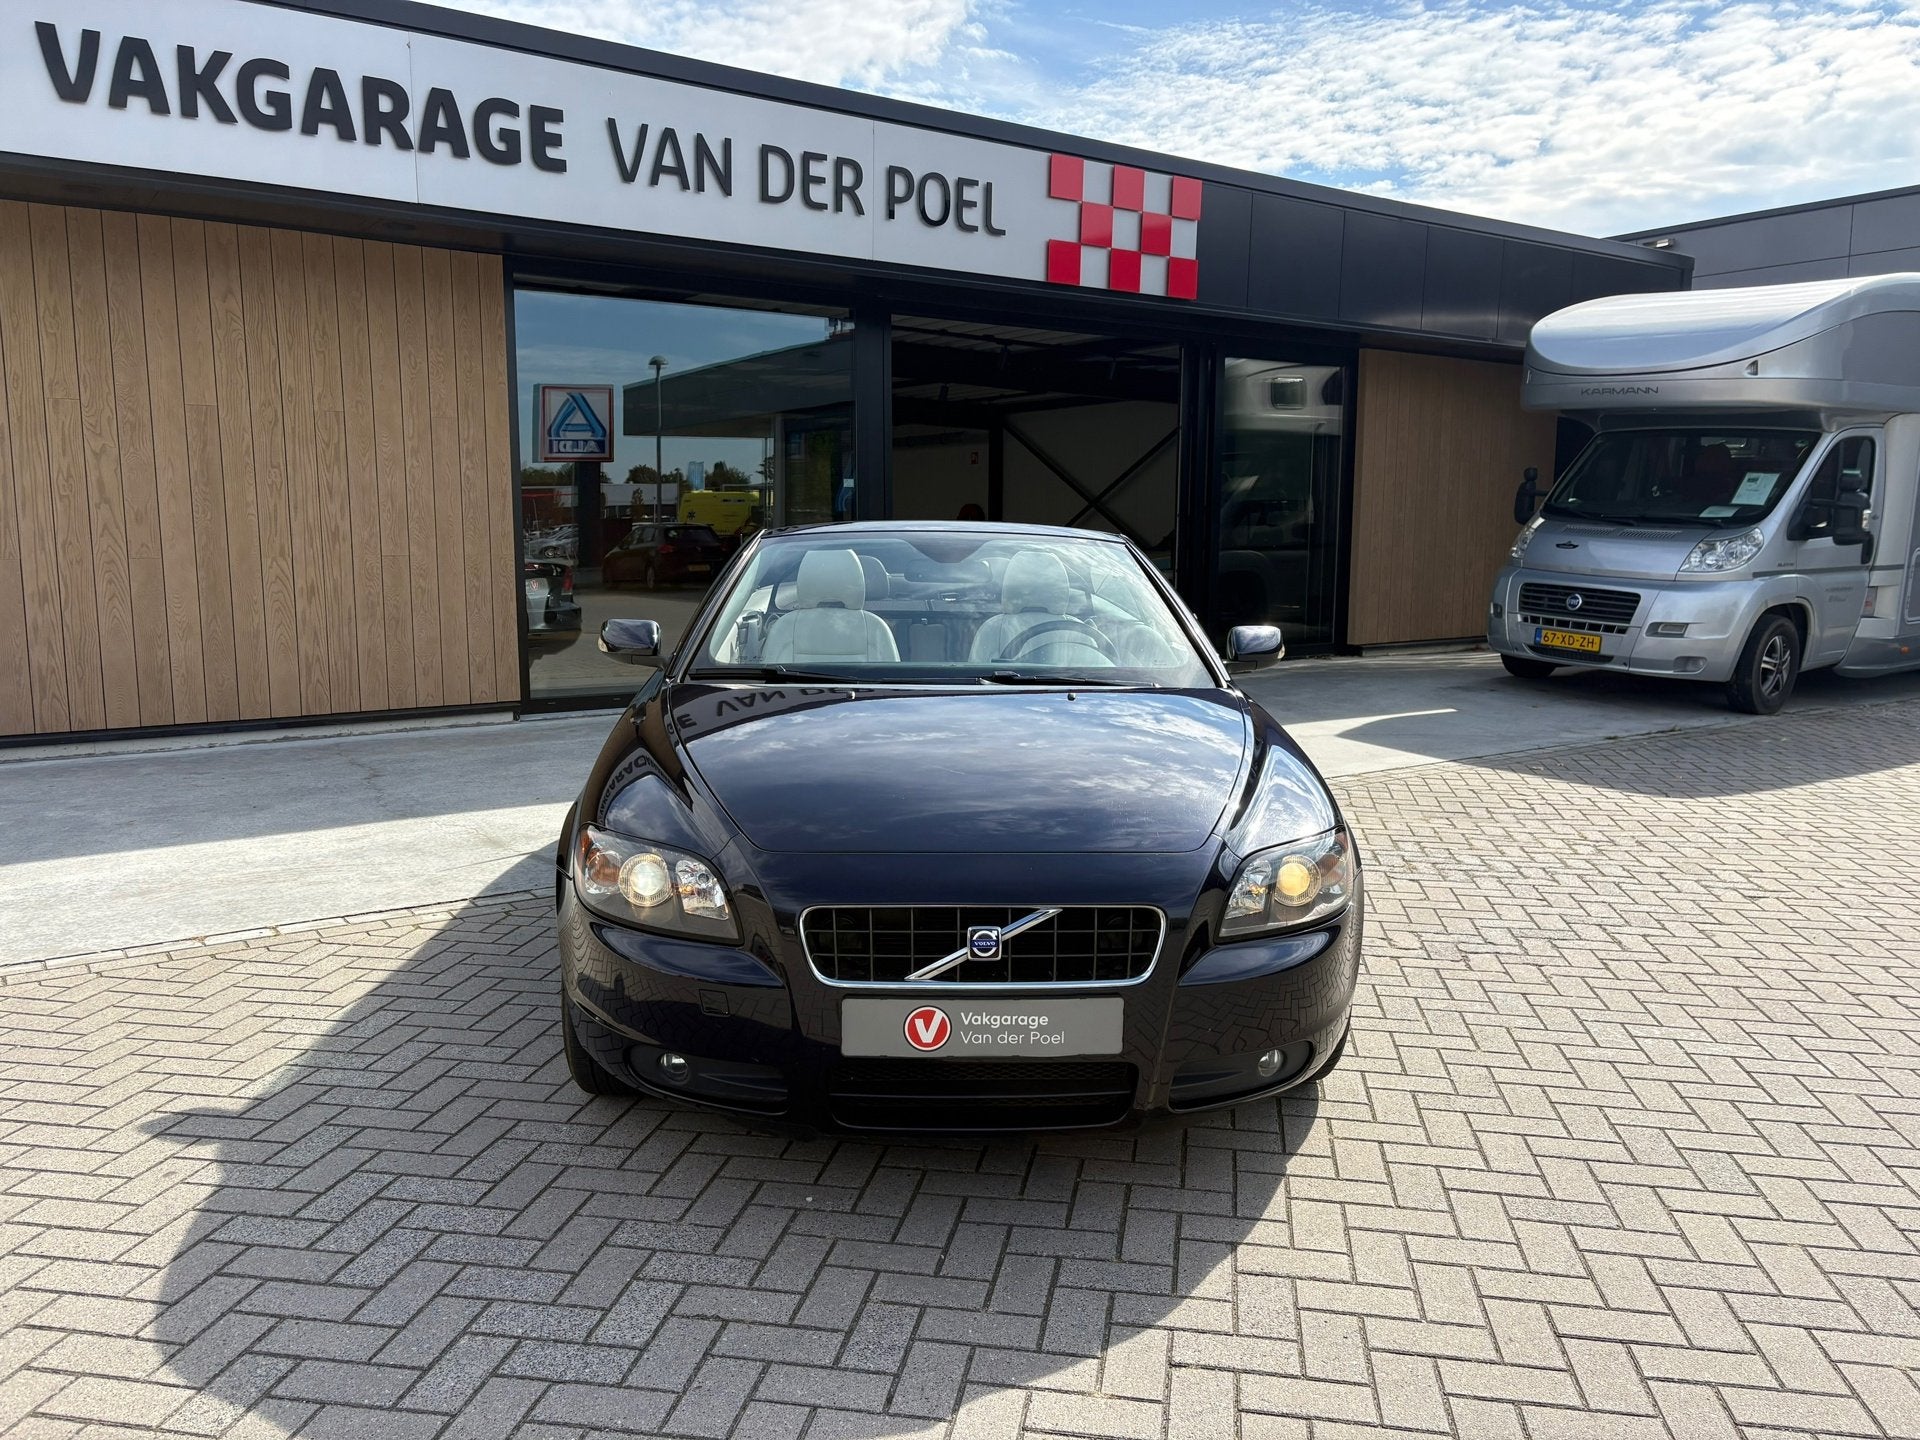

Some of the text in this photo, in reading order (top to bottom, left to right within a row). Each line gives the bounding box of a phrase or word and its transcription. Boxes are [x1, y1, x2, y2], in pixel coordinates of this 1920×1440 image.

[34, 20, 1006, 236] VAKGARAGE VAN DER POEL
[1581, 386, 1659, 396] KARMANN
[960, 1012, 1049, 1029] Vakgarage
[960, 1031, 1065, 1045] Van der Poel
